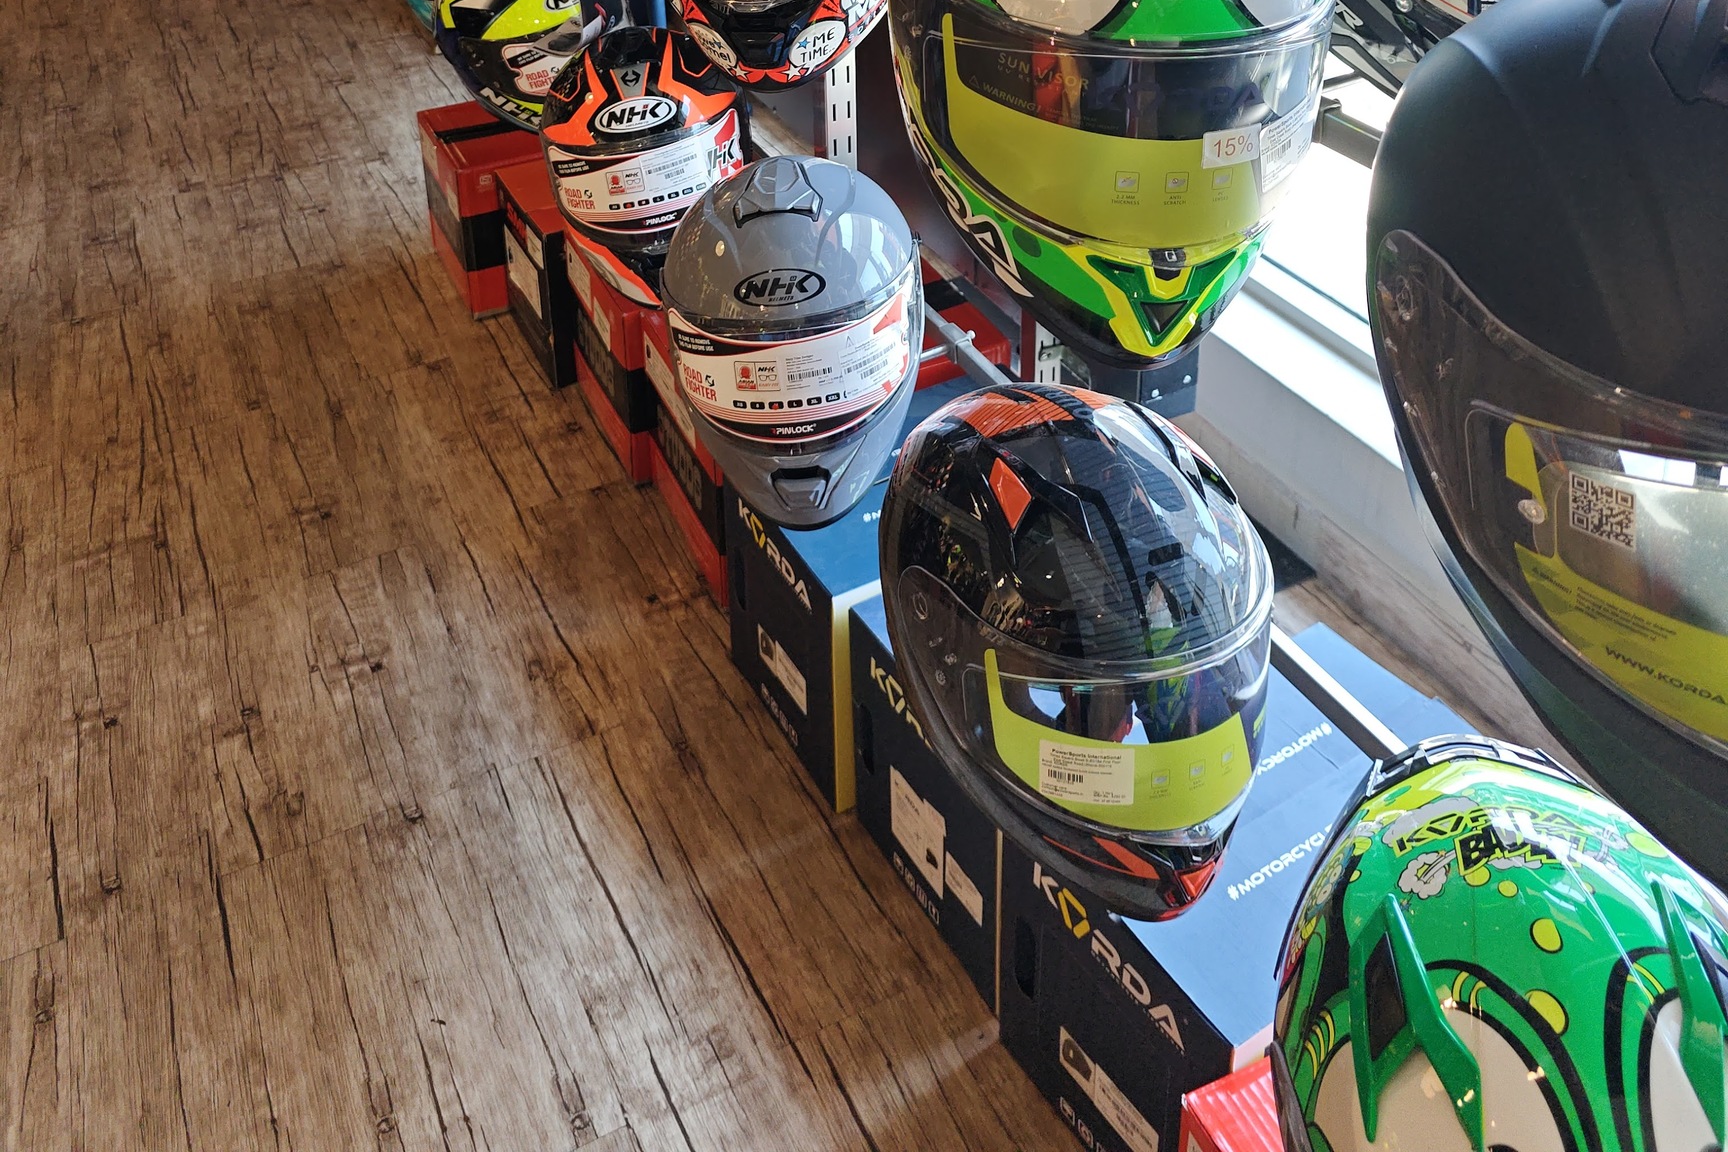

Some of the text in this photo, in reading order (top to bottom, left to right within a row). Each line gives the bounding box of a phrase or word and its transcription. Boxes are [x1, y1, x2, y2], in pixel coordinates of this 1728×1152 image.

[812, 26, 836, 48] ME
[525, 70, 549, 81] ROAD
[998, 51, 1090, 91] SUN VISOR
[529, 76, 557, 89] FIGHT
[606, 101, 664, 128] NHK
[1213, 133, 1254, 158] 15%
[565, 187, 582, 198] ROAD
[567, 197, 595, 210] FIGHTER
[646, 213, 676, 226] PINLOCK
[743, 274, 814, 296] NHK
[683, 363, 703, 384] ROAD
[685, 378, 717, 402] FIGHTER
[776, 423, 814, 435] PINLOCK
[1052, 748, 1087, 758] PowerSports
